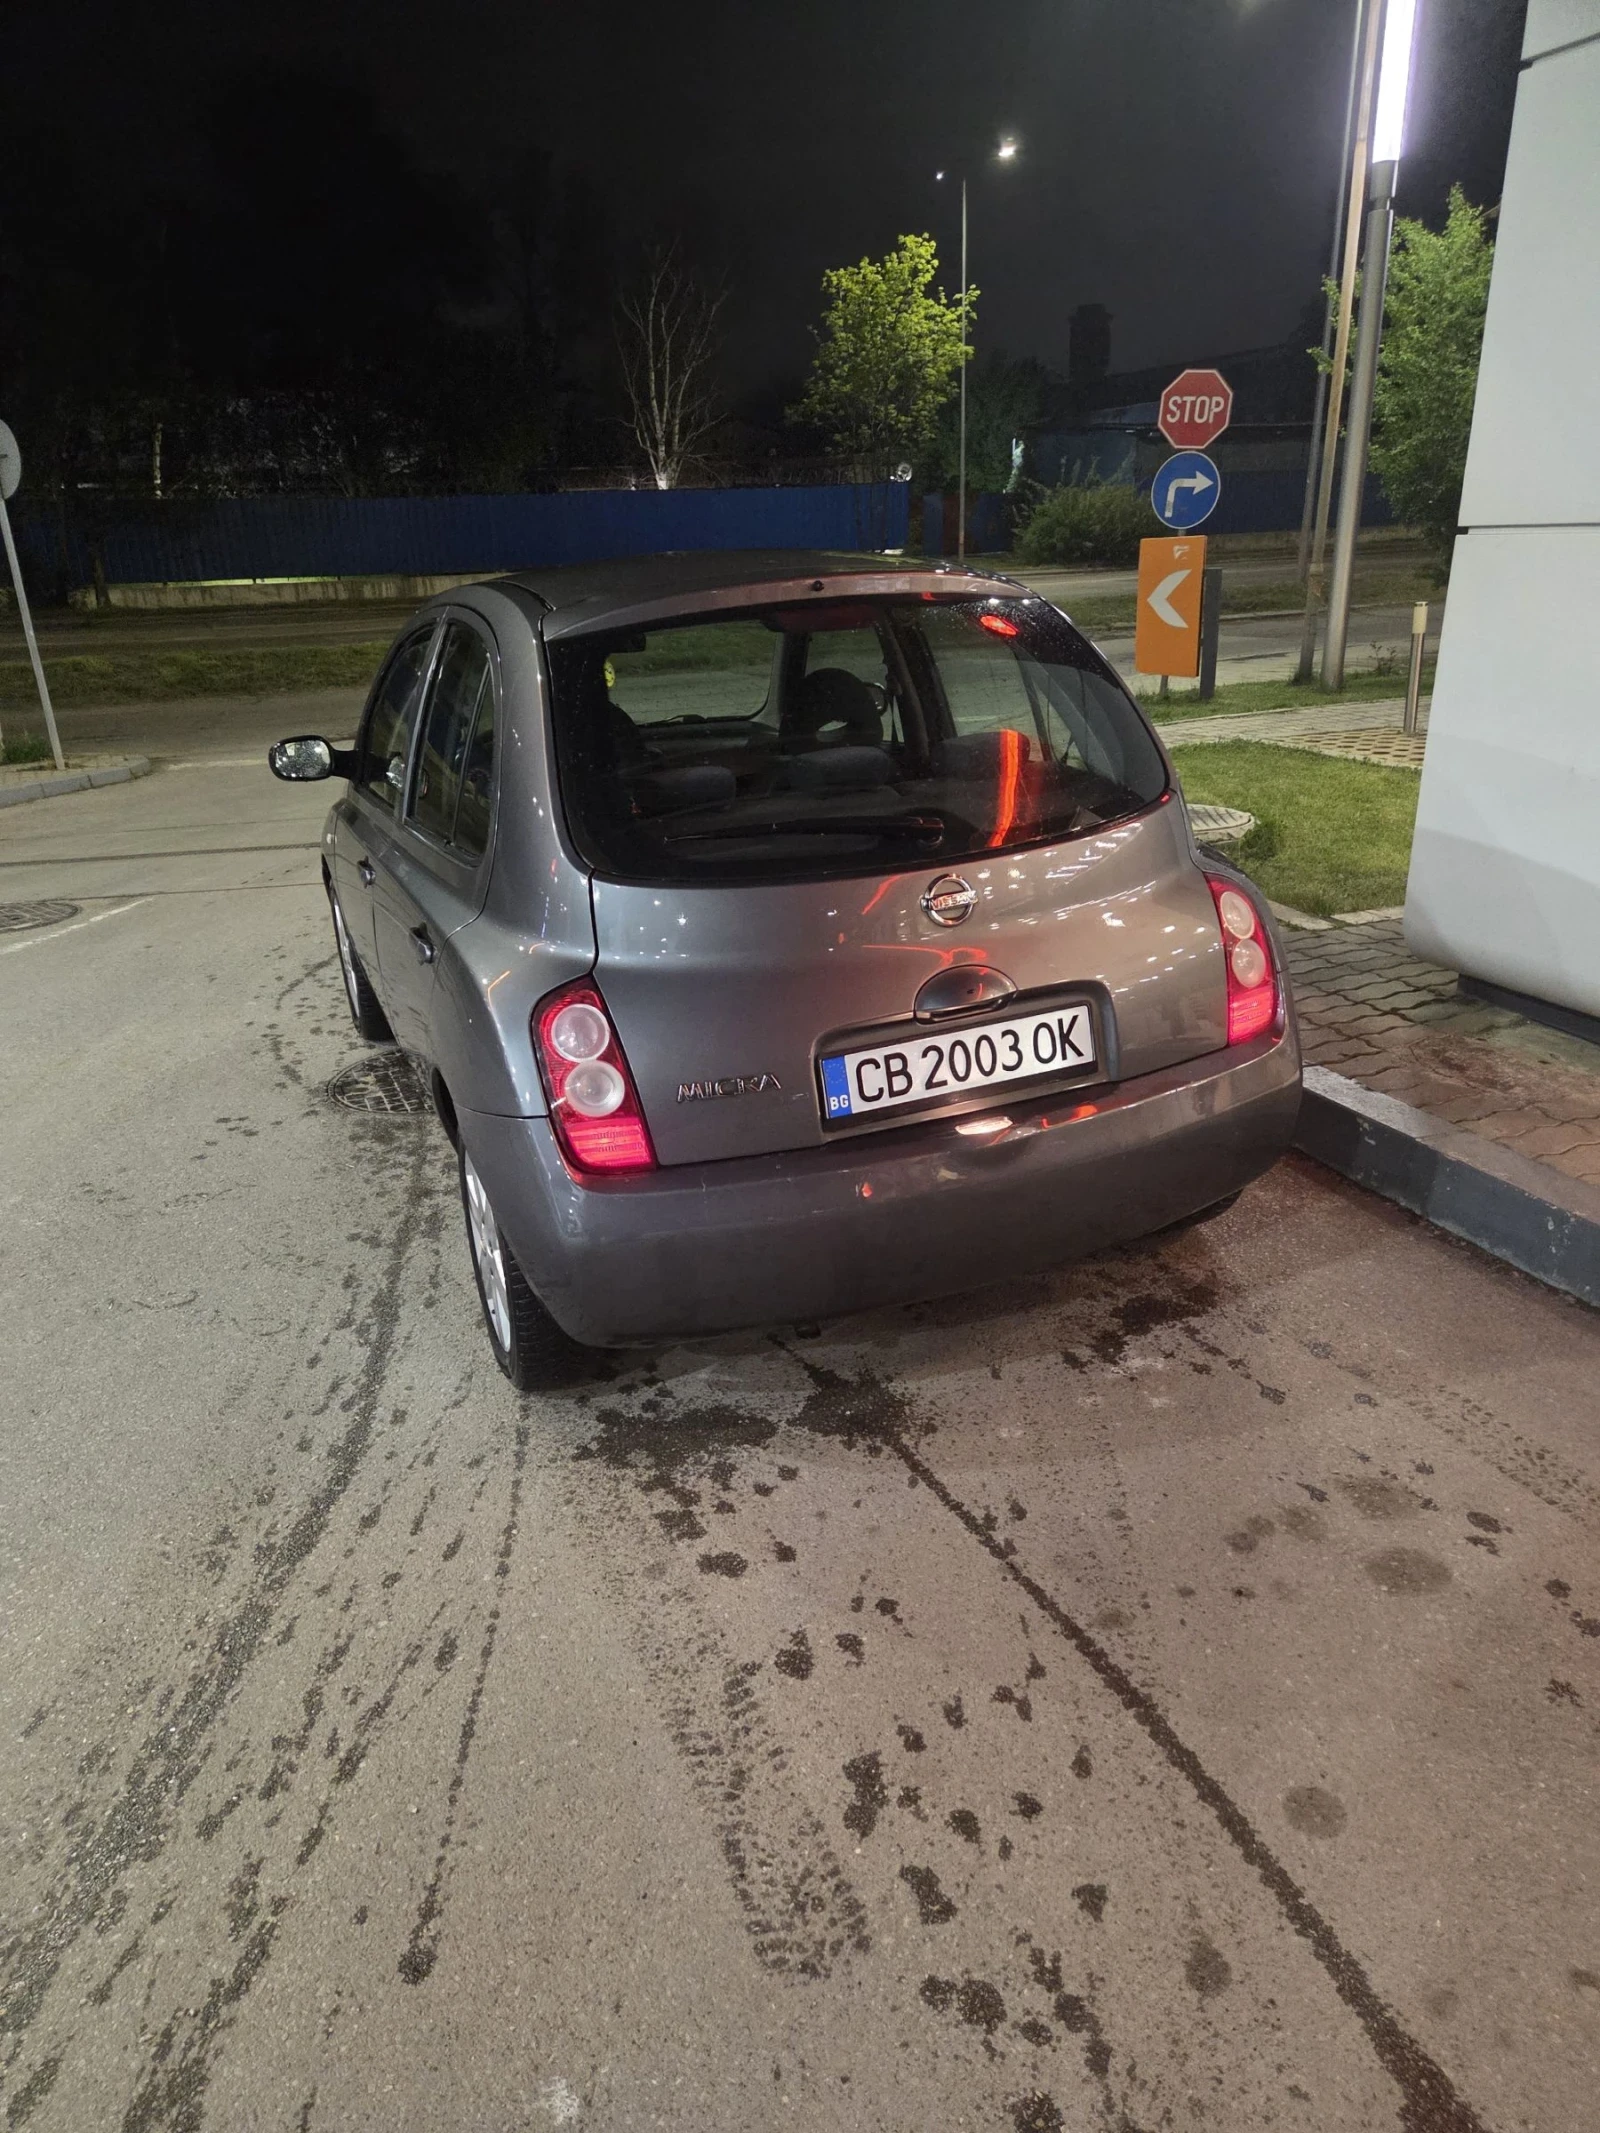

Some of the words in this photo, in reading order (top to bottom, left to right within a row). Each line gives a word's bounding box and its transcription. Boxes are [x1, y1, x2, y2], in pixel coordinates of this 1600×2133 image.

[1166, 396, 1224, 423] STOP
[855, 1052, 913, 1102] CB
[921, 1029, 1023, 1090] 2003
[1033, 1014, 1085, 1064] OK
[677, 1075, 781, 1102] MICRA
[829, 1094, 849, 1110] BG
